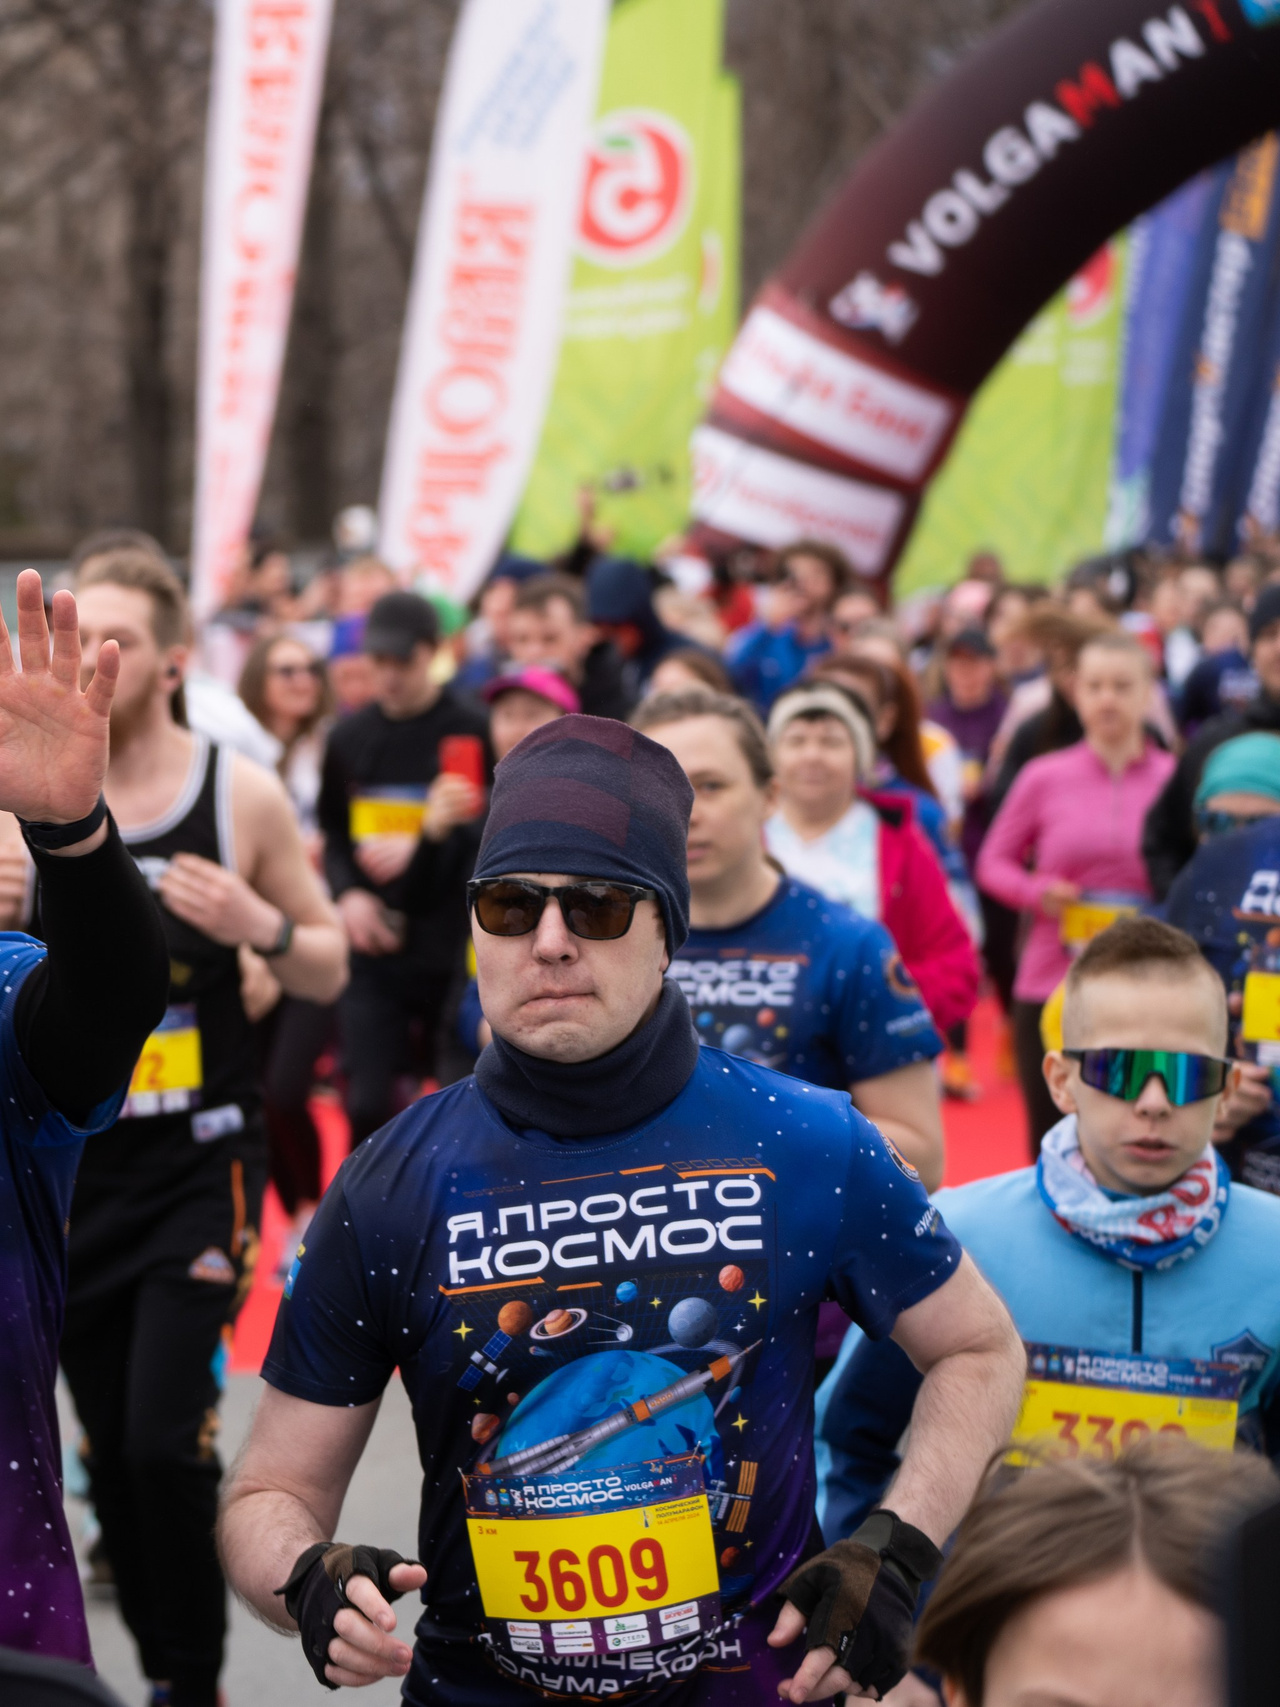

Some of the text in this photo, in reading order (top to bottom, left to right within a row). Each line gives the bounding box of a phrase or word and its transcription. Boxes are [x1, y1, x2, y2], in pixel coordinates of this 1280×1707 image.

[664, 959, 799, 983] РОСТО
[498, 1178, 762, 1236] ПРОСТО
[448, 1215, 764, 1284] КОСМОС
[524, 1487, 625, 1509] КОСМОС
[537, 1477, 621, 1493] ПРОСТО
[513, 1537, 669, 1613] 3609
